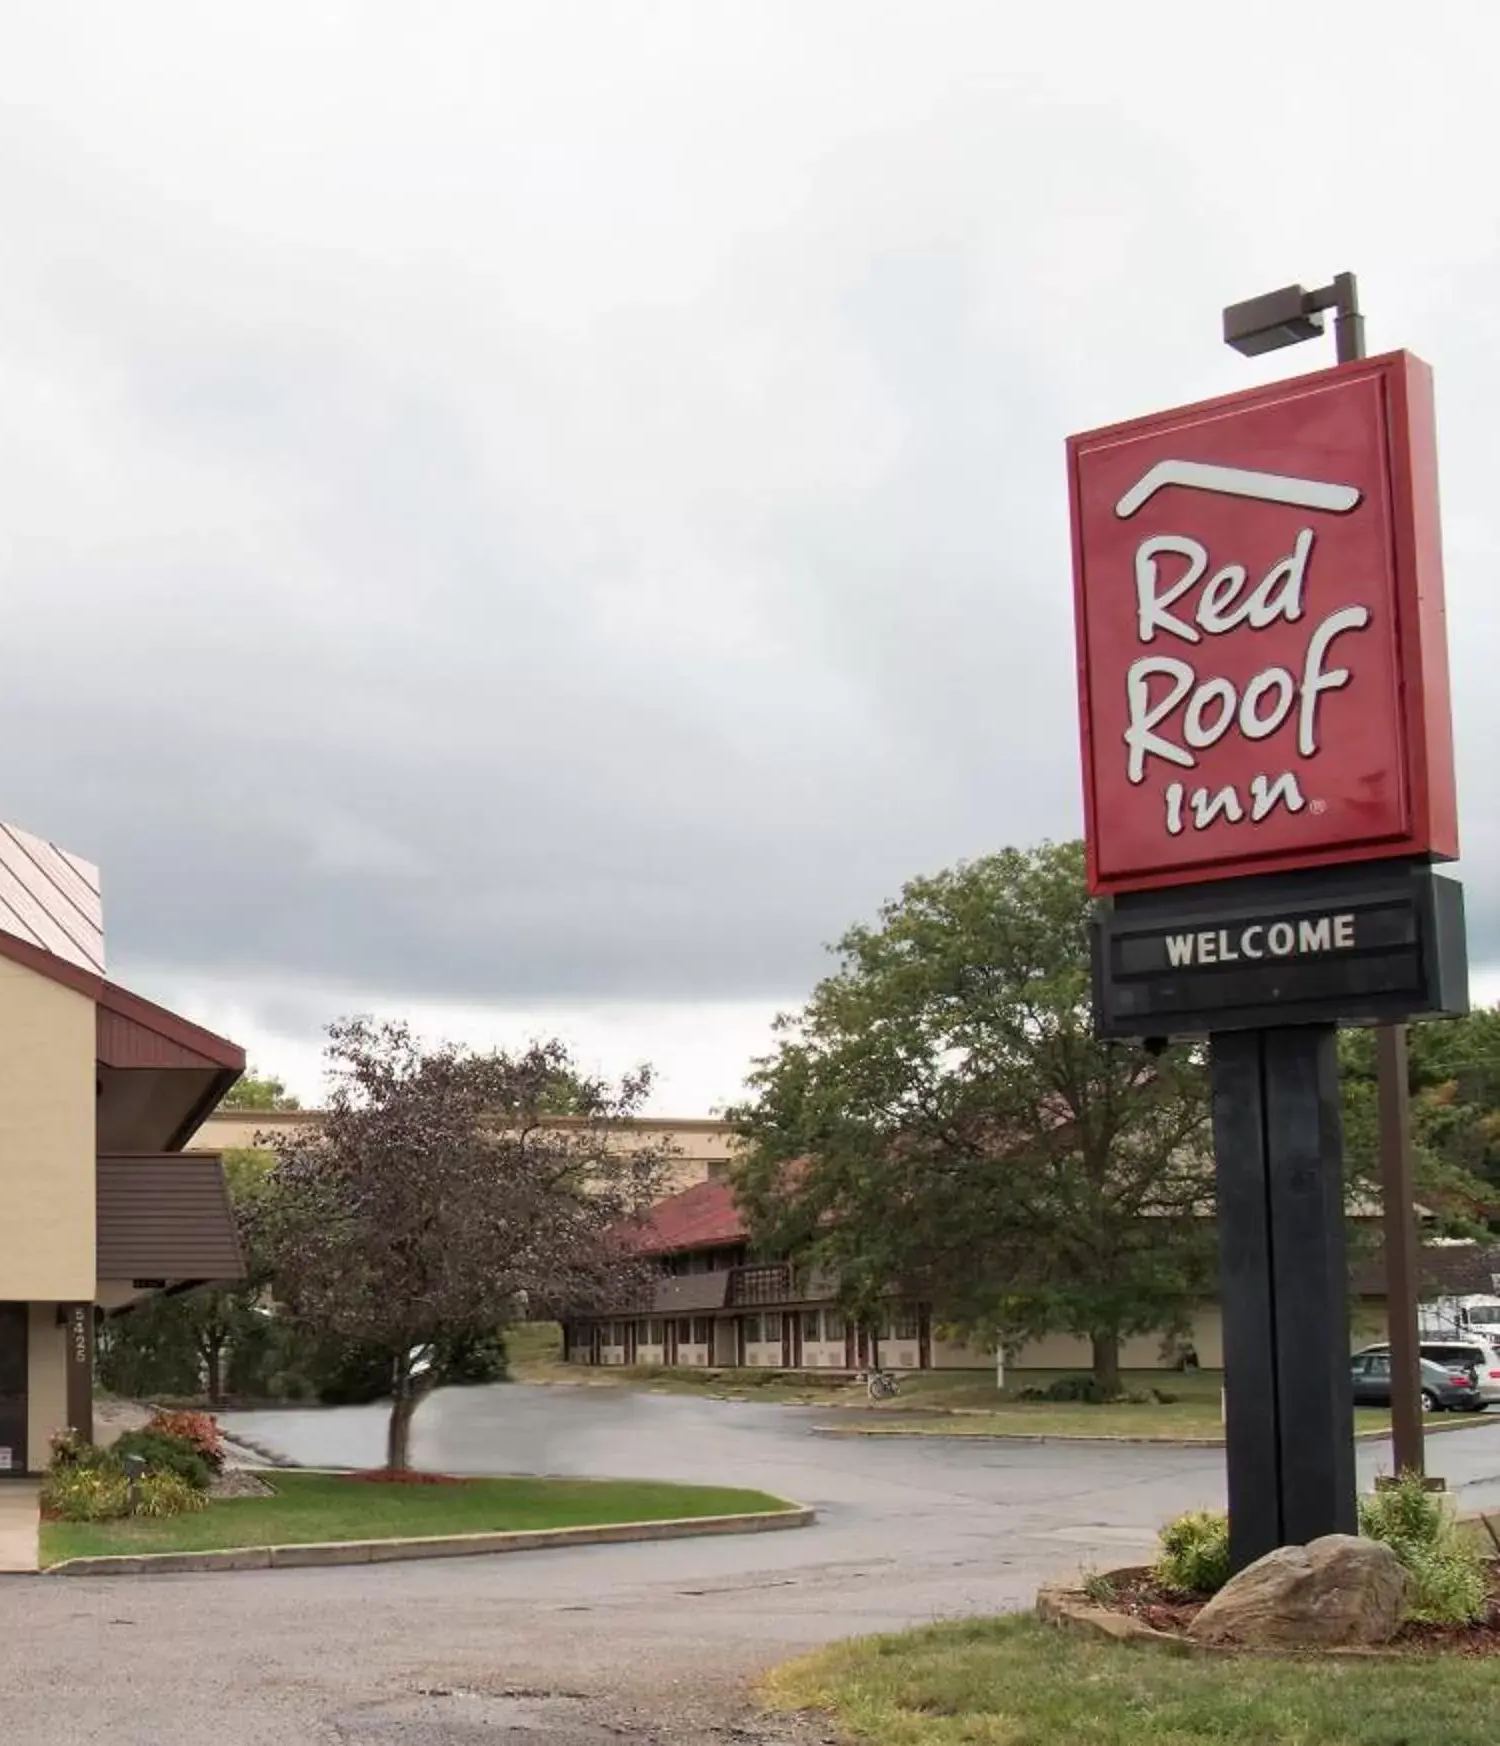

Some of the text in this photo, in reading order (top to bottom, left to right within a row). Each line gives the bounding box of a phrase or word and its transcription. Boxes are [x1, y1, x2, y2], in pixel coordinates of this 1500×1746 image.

[1136, 528, 1315, 643] Red
[1125, 605, 1368, 785] Roof
[1164, 771, 1305, 834] Inn
[1164, 914, 1356, 967] WELCOME
